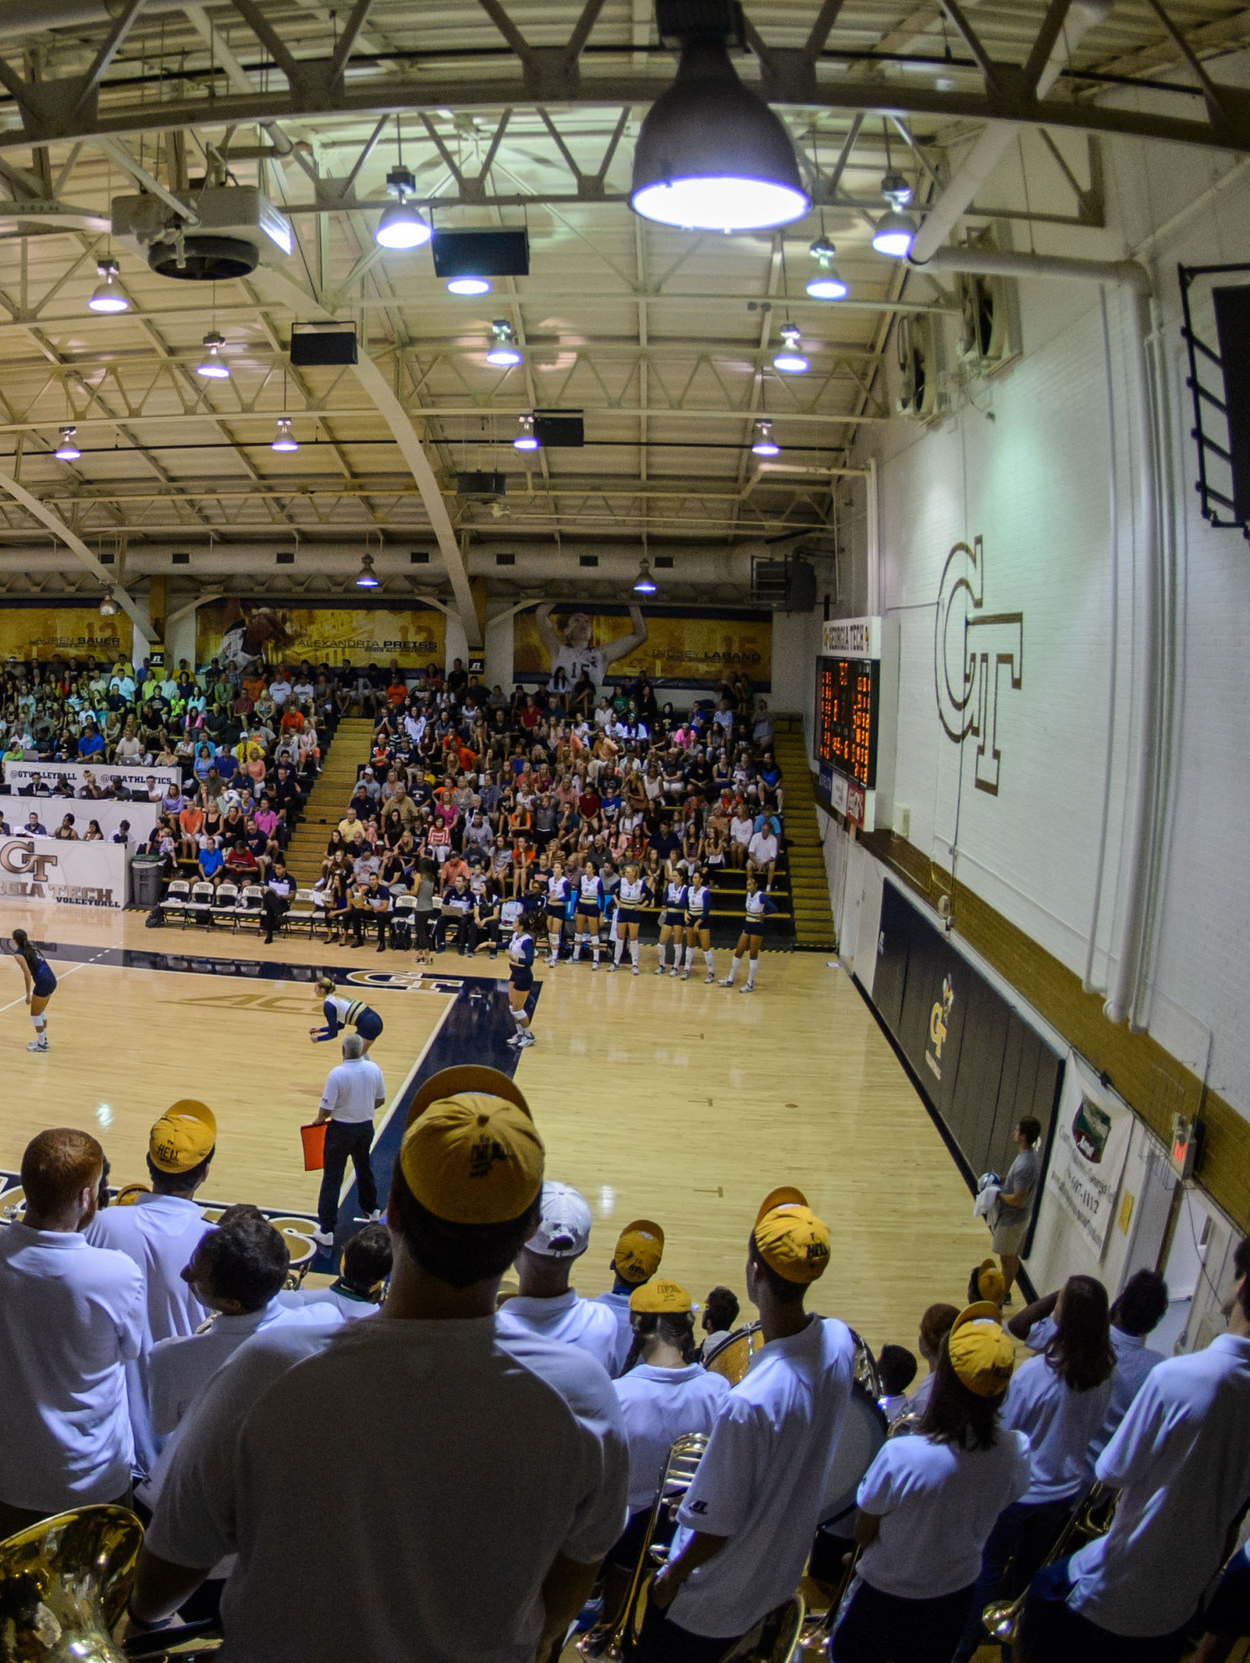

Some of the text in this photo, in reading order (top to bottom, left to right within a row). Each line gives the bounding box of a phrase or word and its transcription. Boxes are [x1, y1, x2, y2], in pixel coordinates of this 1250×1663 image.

[77, 636, 121, 645] SAUER
[298, 638, 438, 649] ALEXANDRIA PREISS
[703, 651, 762, 661] LABAND
[934, 535, 1023, 796] GT
[0, 840, 58, 882] GT
[48, 883, 114, 902] TECH
[55, 896, 122, 909] VOLLEYBALL
[346, 969, 465, 994] GT
[156, 1144, 181, 1162] HELL
